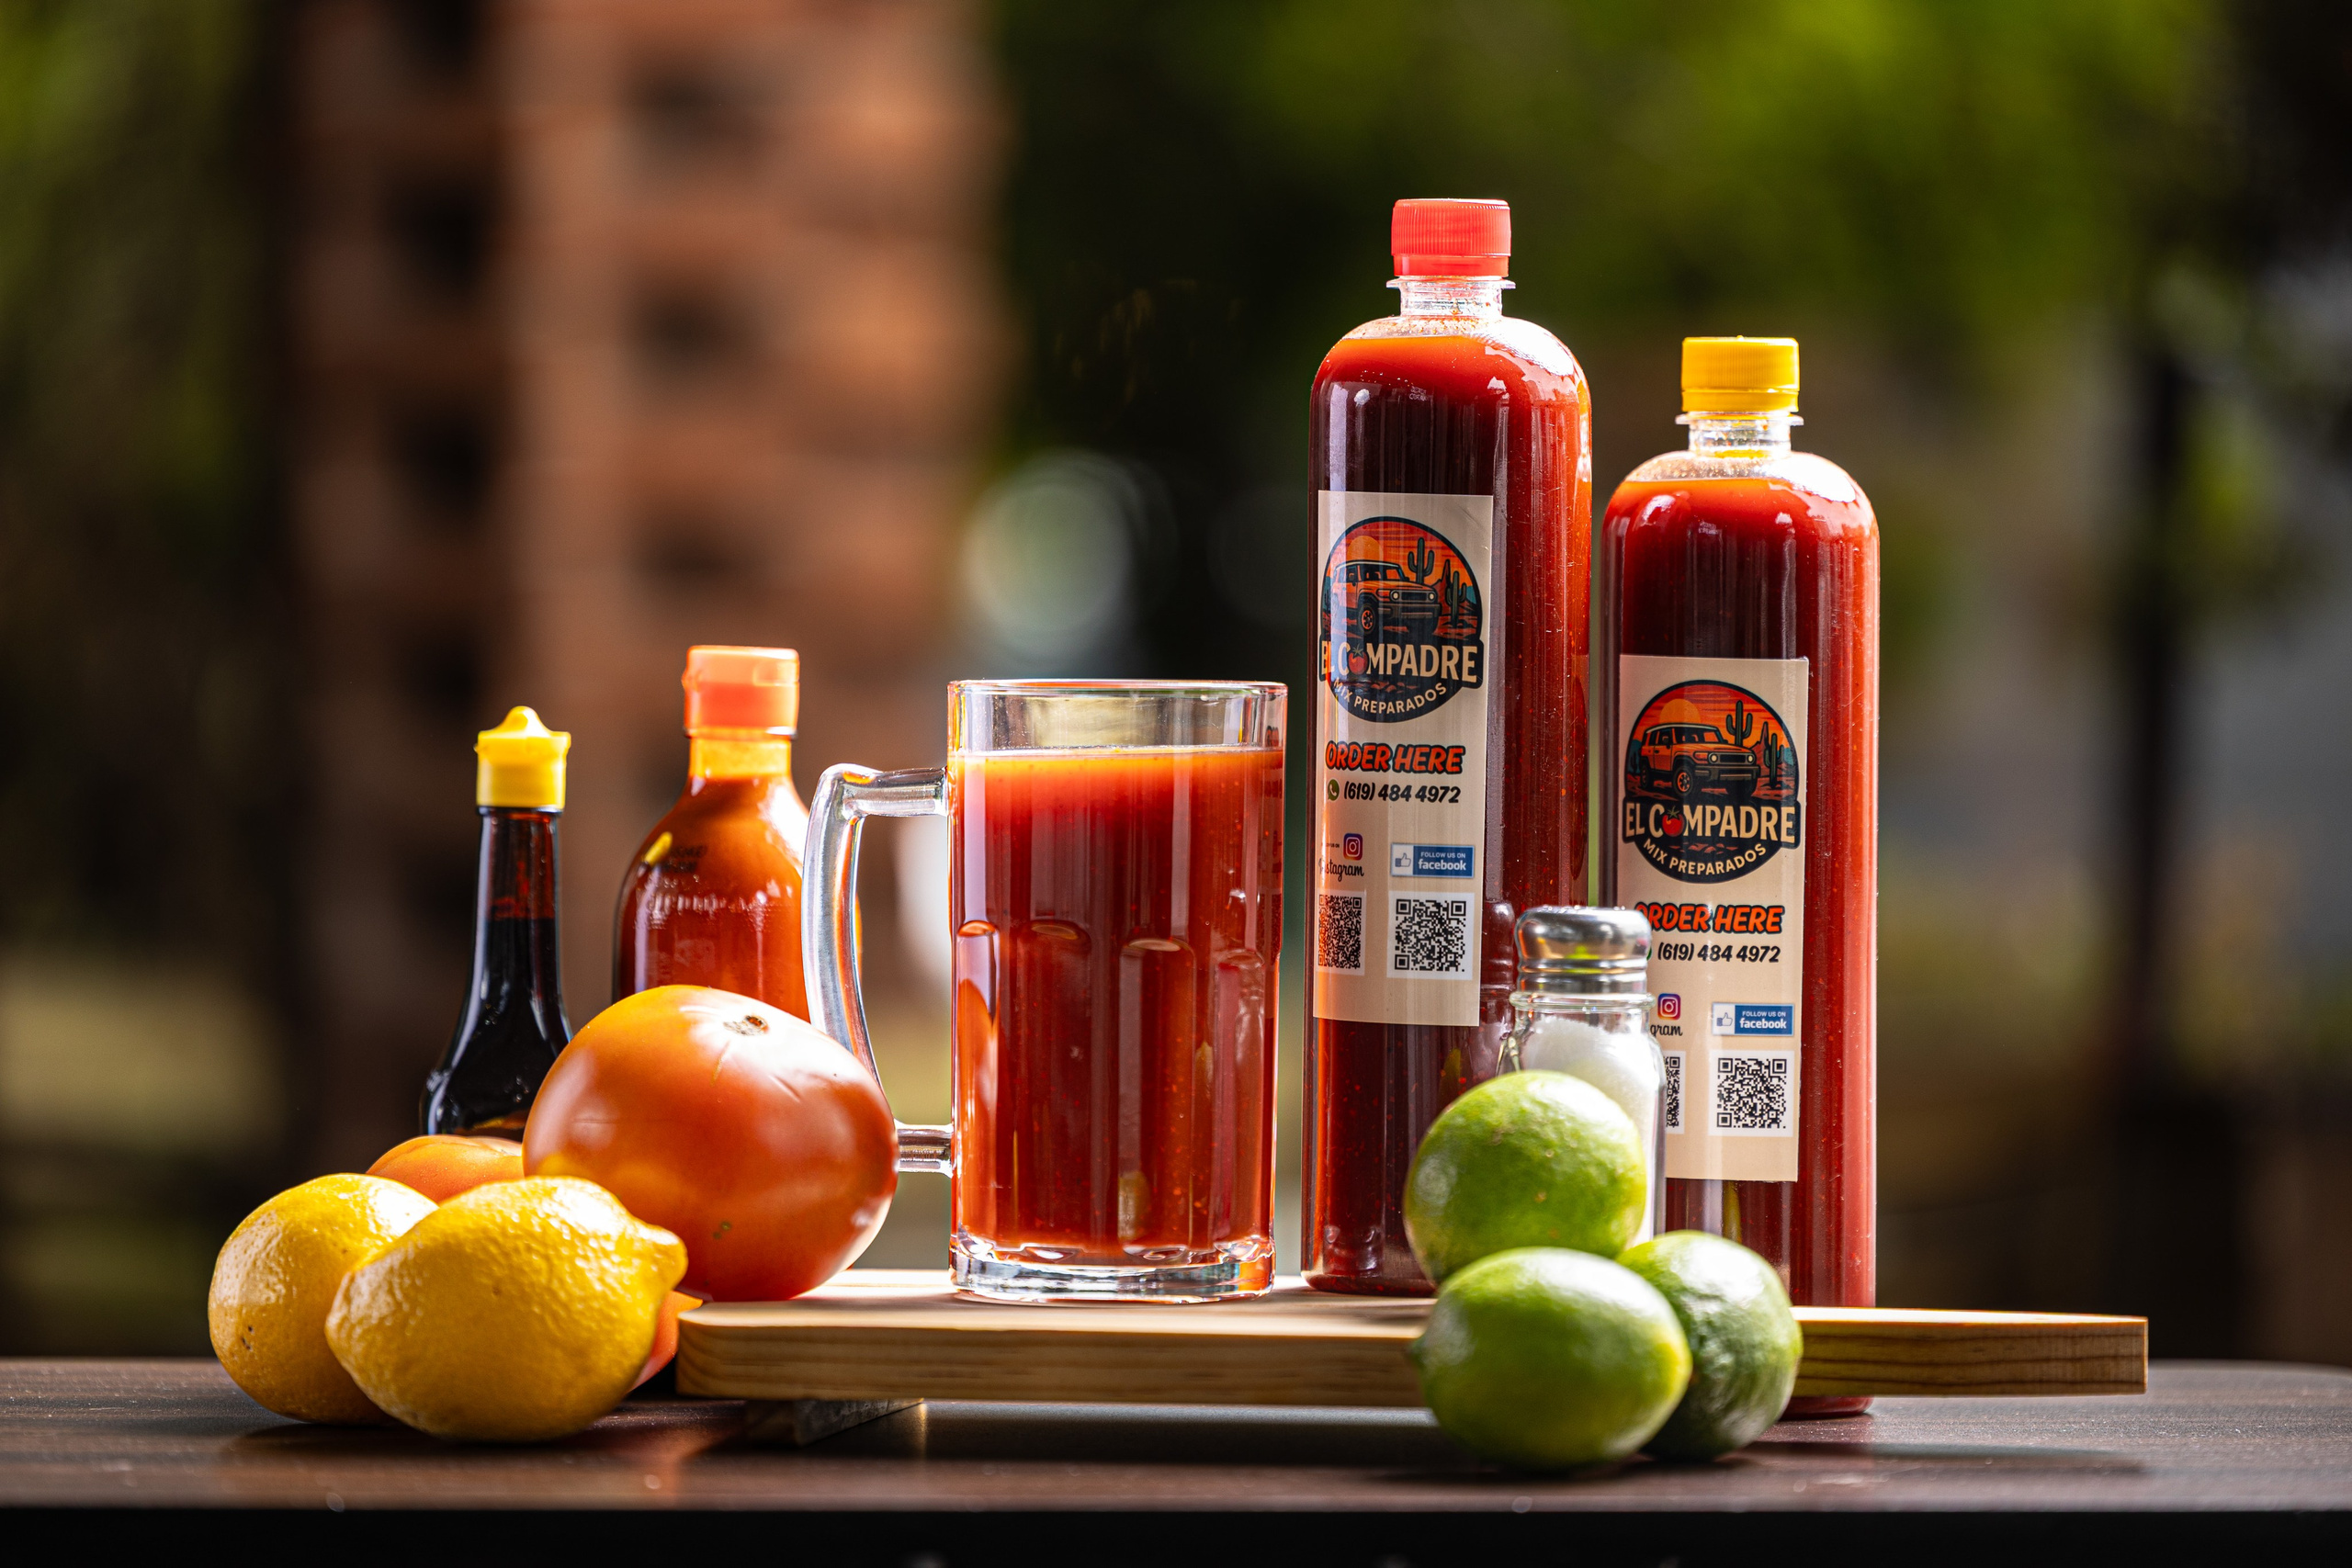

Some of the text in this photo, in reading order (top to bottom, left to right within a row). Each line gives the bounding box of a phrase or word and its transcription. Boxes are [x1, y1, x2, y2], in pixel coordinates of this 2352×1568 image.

[1333, 676, 1447, 715] MIX PREPARADOS
[1326, 740, 1466, 774] ORDER HERE
[1343, 781, 1462, 803] (619) 484 4972
[1624, 802, 1645, 838] EL
[1418, 858, 1467, 871] facebook
[1643, 837, 1767, 875] MIX PREPARADOS
[1713, 904, 1786, 935] HERE
[1657, 942, 1781, 964] (619) 484 4972
[1739, 1017, 1787, 1029] facebook
